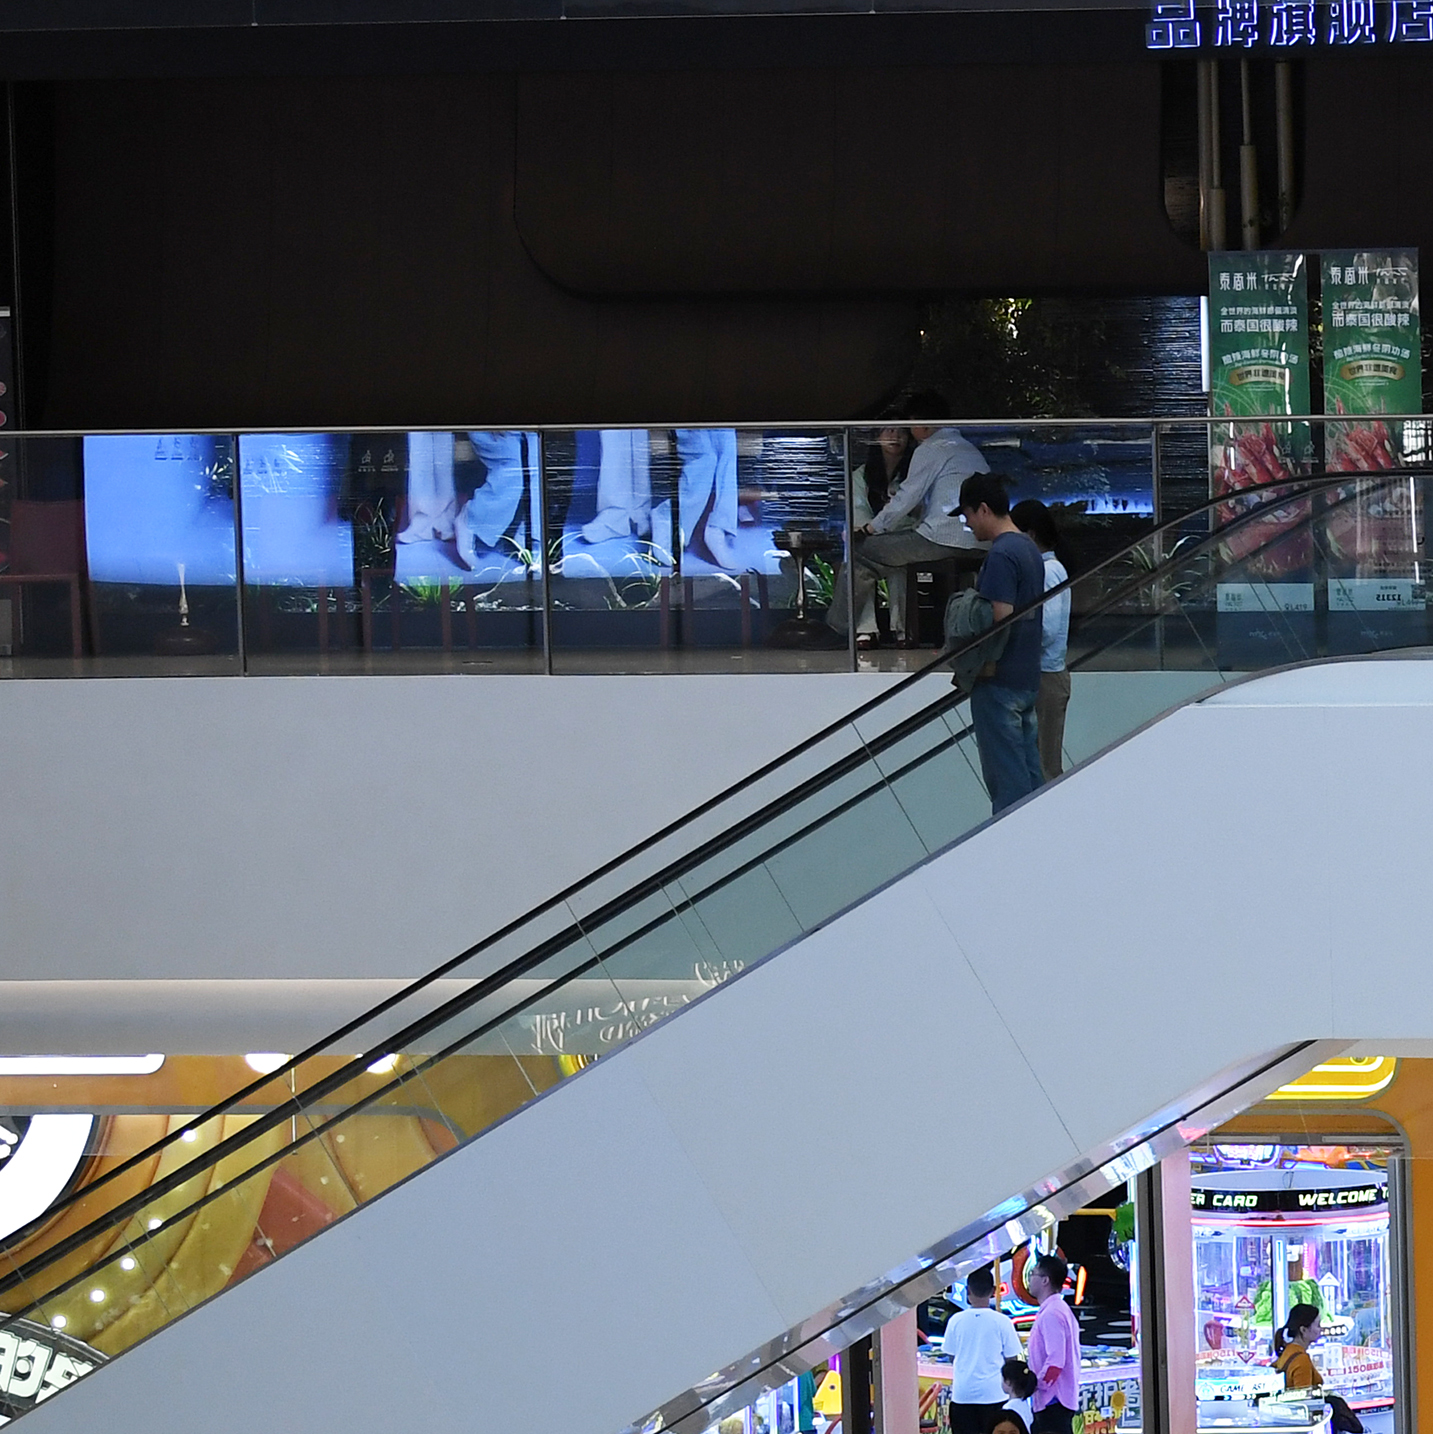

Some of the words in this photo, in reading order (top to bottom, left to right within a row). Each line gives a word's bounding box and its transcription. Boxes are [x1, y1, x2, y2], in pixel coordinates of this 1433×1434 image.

[1147, 0, 1433, 48] 品牌旗舰店
[1220, 318, 1298, 333] 而泰国很酸辣
[1332, 311, 1410, 327] 而泰国很酸辣
[1213, 1194, 1258, 1207] CARD
[1298, 1189, 1377, 1206] WELCOME
